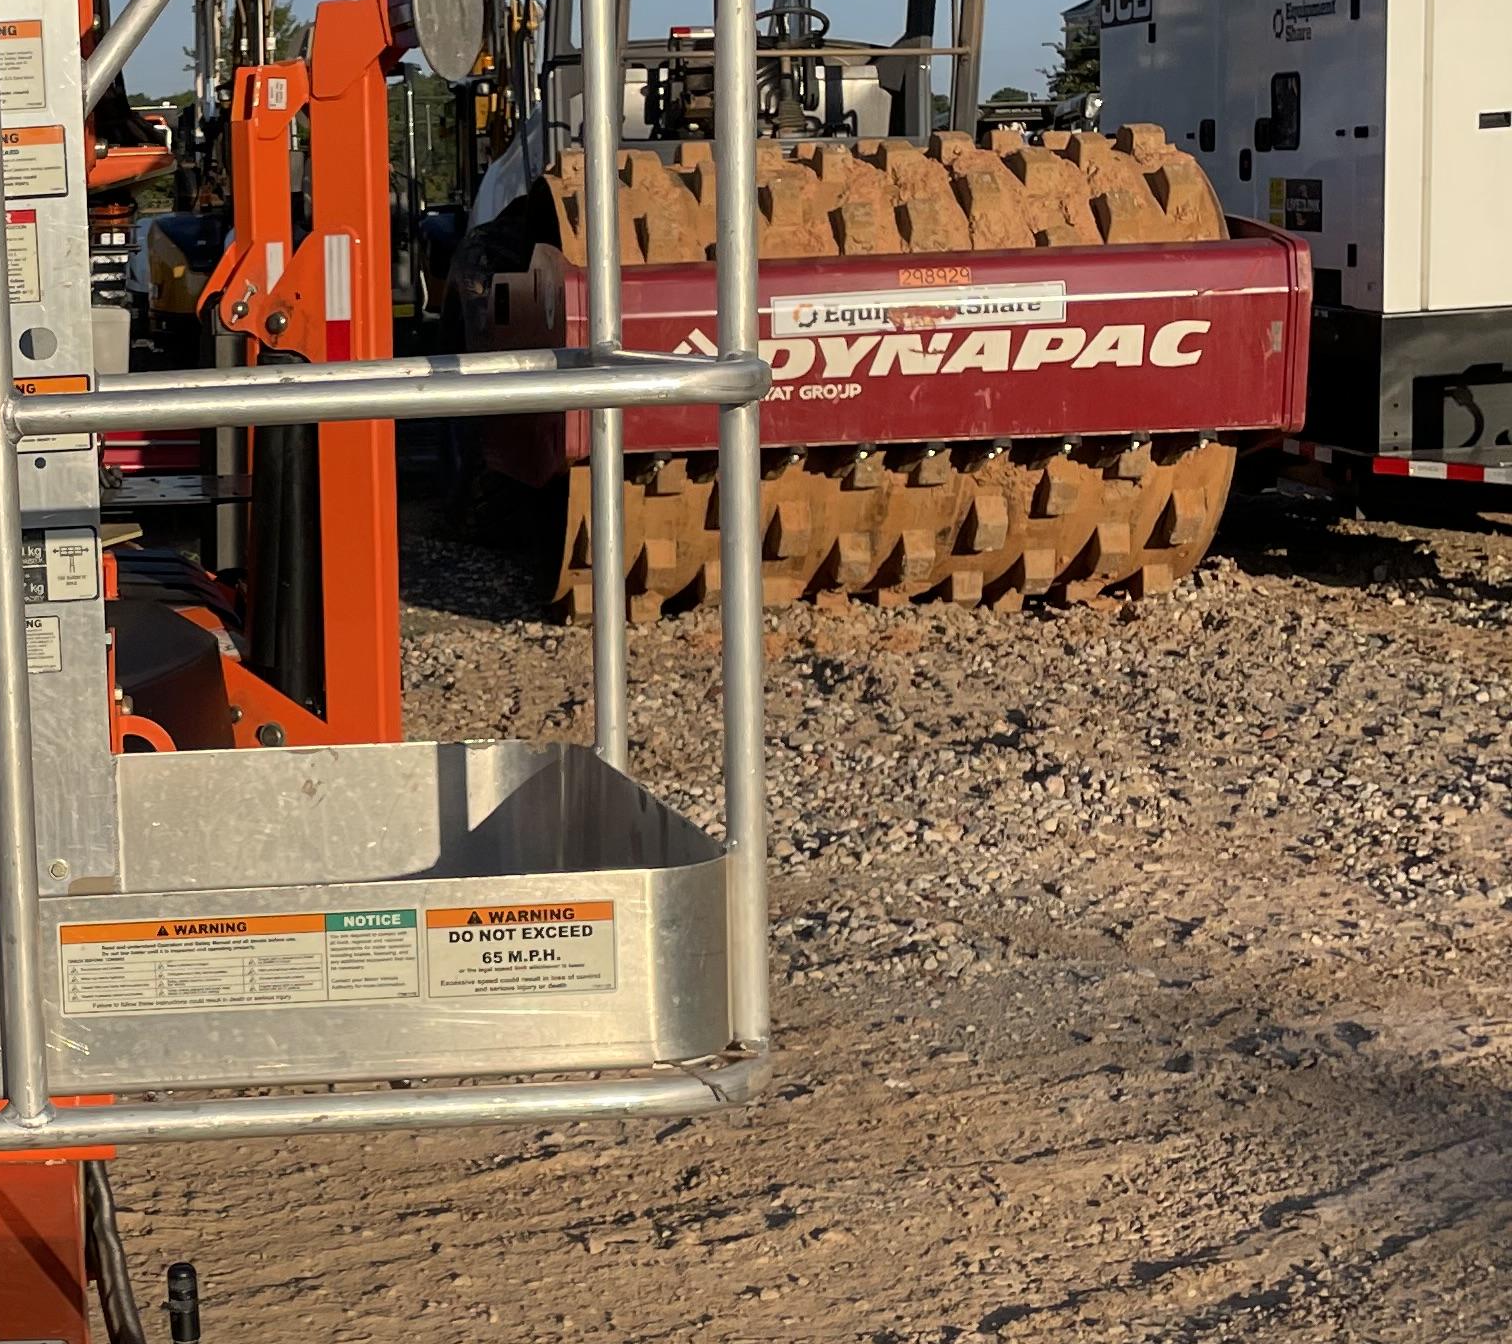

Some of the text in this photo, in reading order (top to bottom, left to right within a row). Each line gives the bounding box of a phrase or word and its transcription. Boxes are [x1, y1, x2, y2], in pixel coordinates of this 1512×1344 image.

[1285, 25, 1311, 42] Share
[901, 267, 971, 285] 298929
[759, 320, 1211, 381] DYNAPAC
[799, 383, 862, 400] GROUP
[30, 583, 44, 595] kg
[343, 913, 402, 927] NOTICE
[488, 908, 575, 924] WARNING
[174, 922, 248, 936] WARNING
[449, 925, 593, 943] DO NOT EXCEED
[482, 949, 562, 964] 65 M.P.H.
